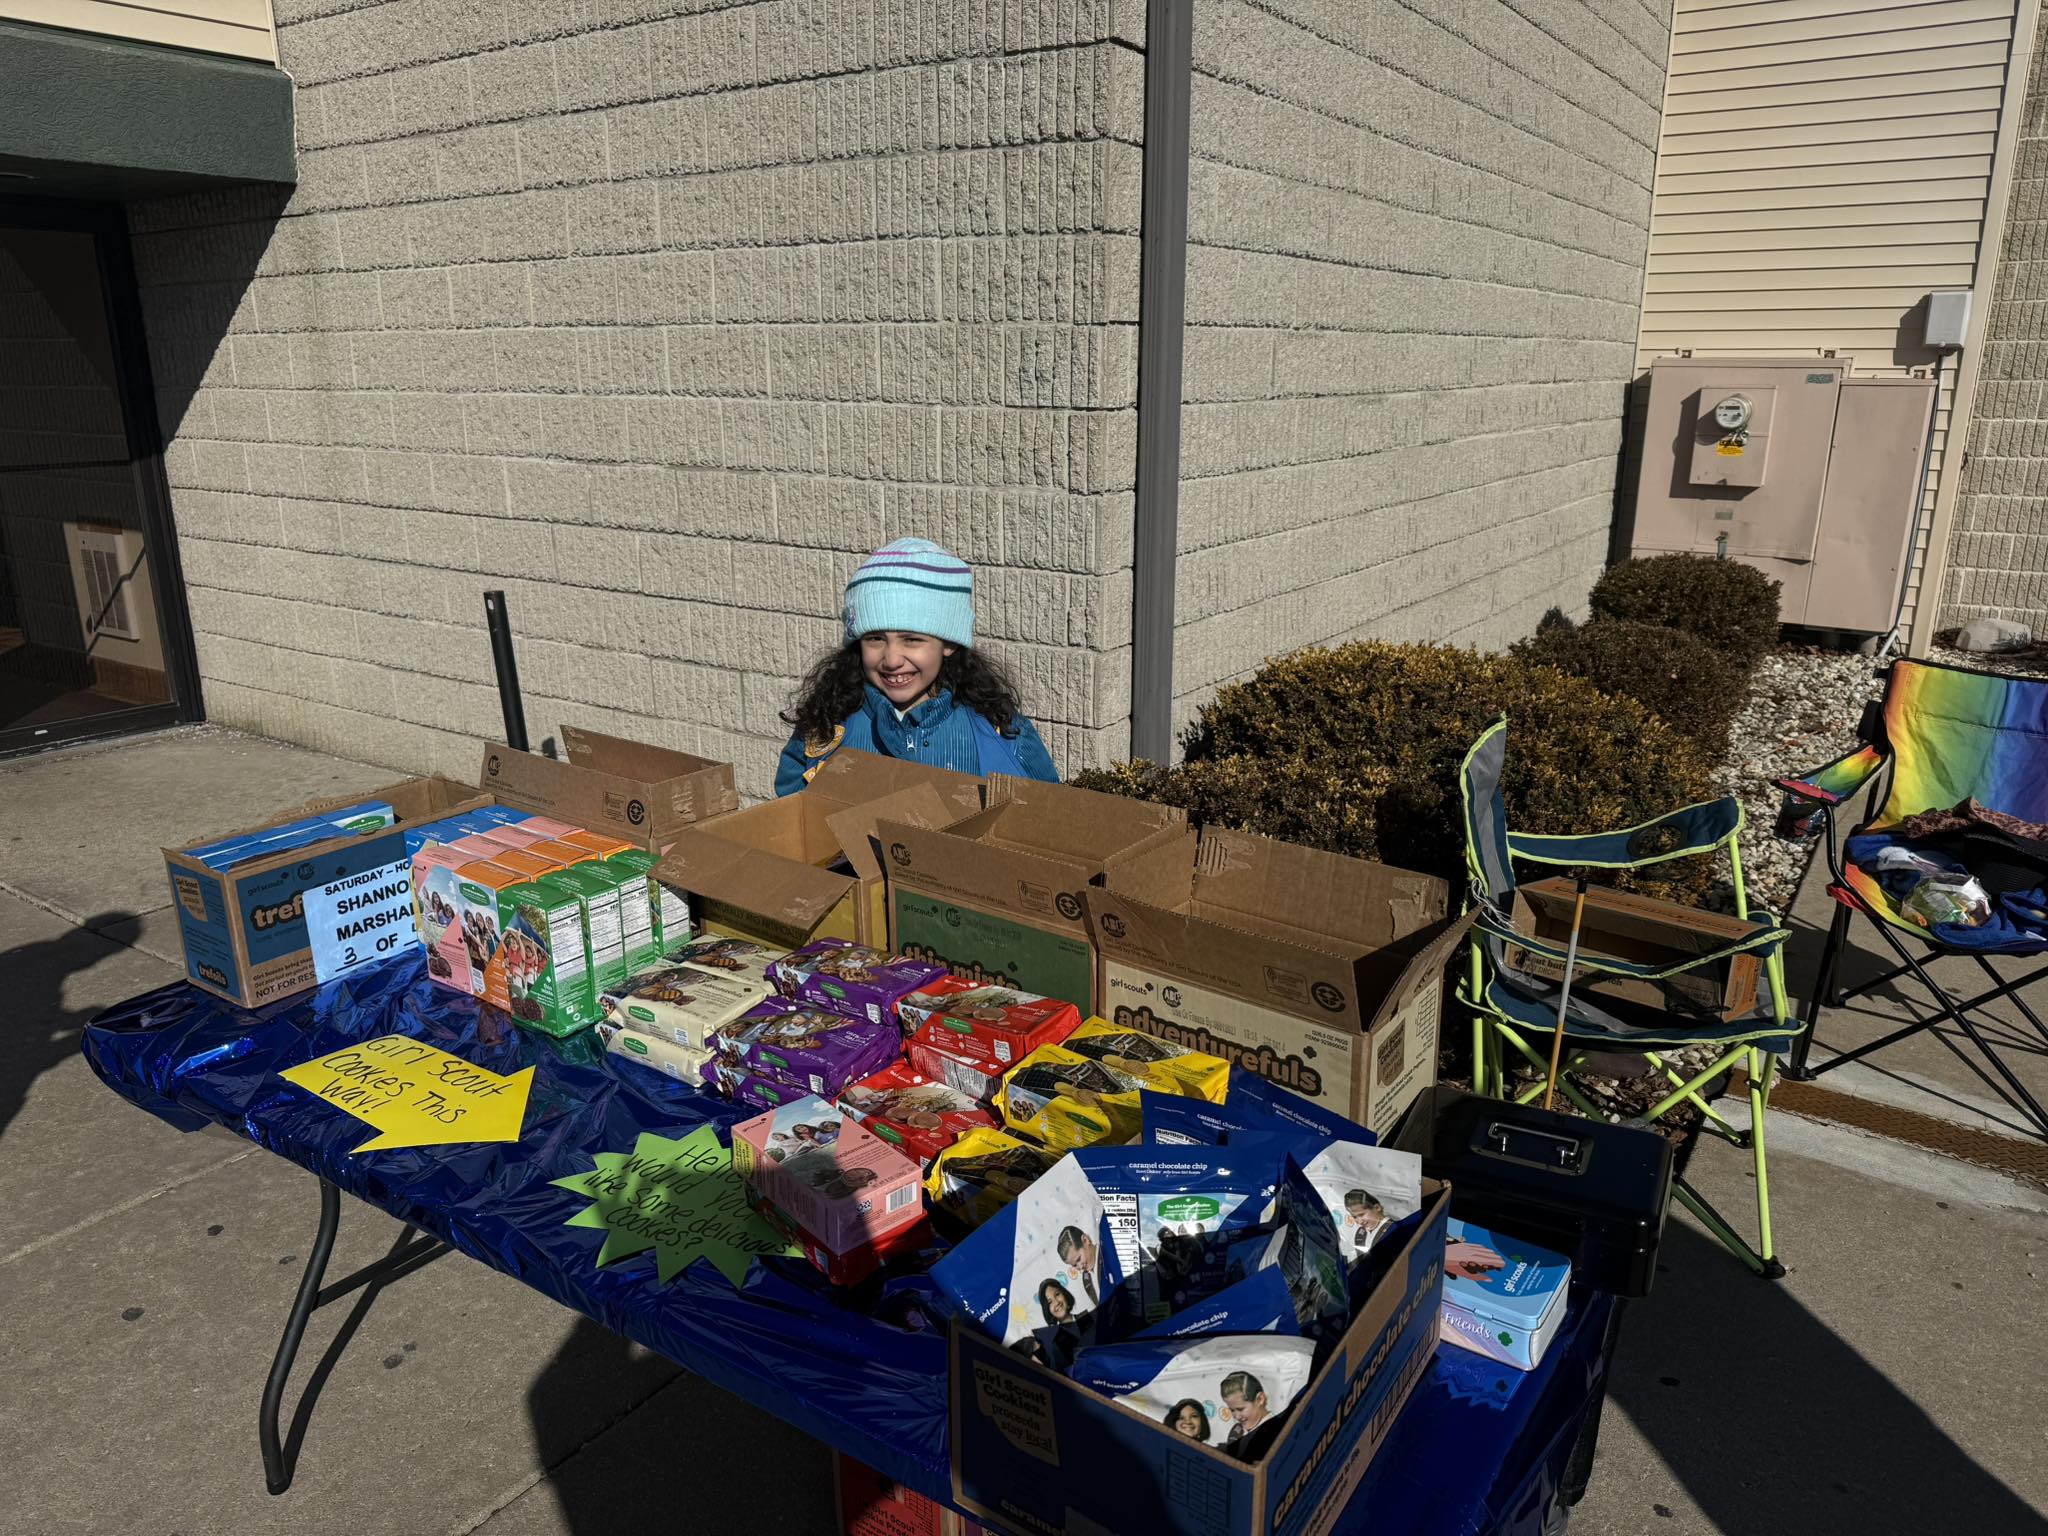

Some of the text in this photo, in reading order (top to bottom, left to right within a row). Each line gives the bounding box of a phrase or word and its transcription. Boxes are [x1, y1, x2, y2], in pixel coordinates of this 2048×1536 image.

[325, 868, 384, 896] SATURDAY
[252, 893, 304, 930] tref
[337, 879, 410, 915] SHANNO
[343, 932, 399, 966] 3 OF
[256, 985, 275, 998] NOT
[277, 978, 297, 991] FOR
[298, 971, 316, 983] RES
[1110, 977, 1147, 995] girl scouts
[366, 1036, 436, 1066] Girl
[1116, 1007, 1320, 1094] adventurefuls
[412, 1090, 468, 1124] This
[1196, 1112, 1222, 1127] caramel
[1128, 1161, 1208, 1171] caramel chocolate chip
[583, 1167, 629, 1195] like
[688, 1214, 793, 1255] delicious
[1504, 1261, 1528, 1294] girl scouts
[978, 1296, 1007, 1324] girl scouts
[1172, 1310, 1229, 1336] hocolate chip
[1343, 1304, 1412, 1417] chocolate
[1411, 1261, 1439, 1310] chip
[1444, 1311, 1492, 1340] Friends
[975, 1367, 1047, 1406] Girl Scout
[1092, 1378, 1132, 1390] girl scouts
[1000, 1421, 1024, 1440] stay
